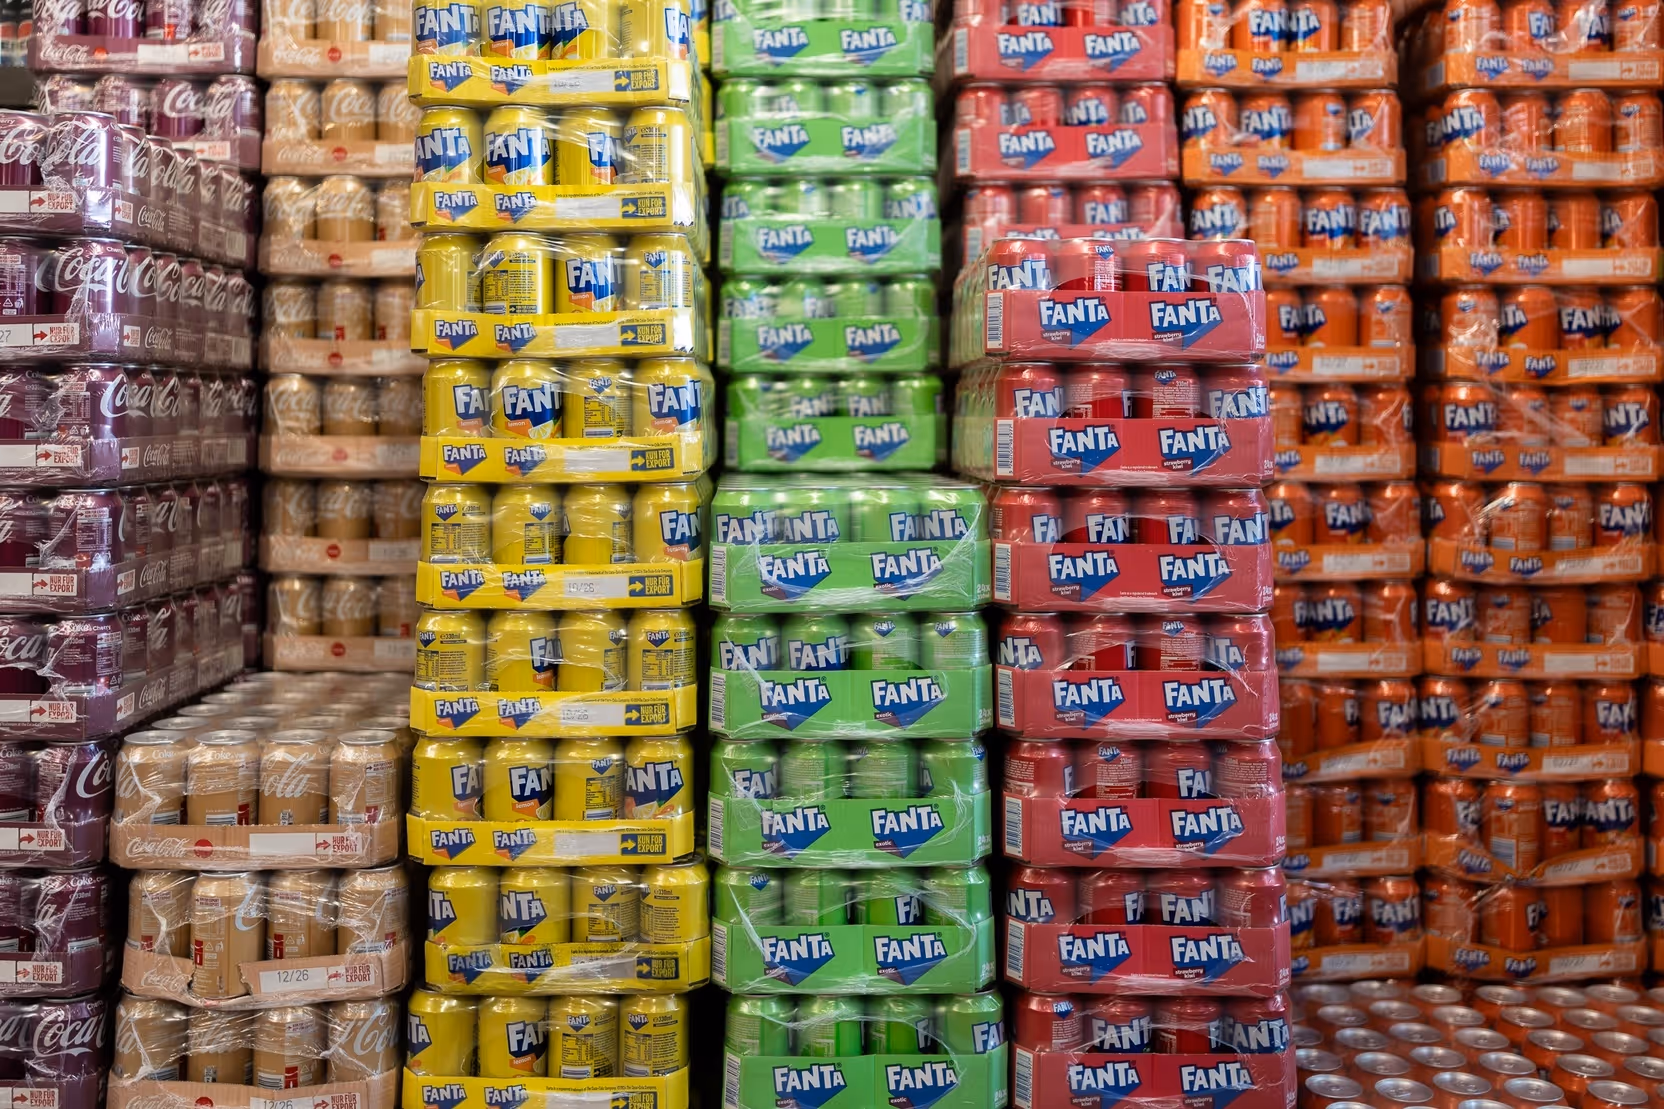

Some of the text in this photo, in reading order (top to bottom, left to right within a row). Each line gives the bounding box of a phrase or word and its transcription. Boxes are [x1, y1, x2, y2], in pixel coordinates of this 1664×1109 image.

[415, 4, 480, 35] FANTA
[754, 27, 809, 49] FANTA
[841, 27, 896, 50] FANTA
[998, 32, 1054, 55] FANTA
[1085, 32, 1141, 56] FANTA
[429, 61, 473, 79] FANTA
[490, 64, 534, 80] FANTA
[630, 79, 656, 89] EXPORT
[754, 125, 810, 147] FANTA
[842, 124, 897, 148] FANTA
[998, 131, 1055, 155] FANTA
[1086, 130, 1143, 155] FANTA
[485, 128, 550, 163] FANTA
[434, 191, 479, 209] FANTA
[494, 192, 537, 210] FANTA
[637, 198, 649, 208] KUN
[637, 206, 664, 217] EXPORT
[759, 226, 812, 248] FANTA
[846, 226, 898, 249] FANTA
[1266, 253, 1299, 267] FANTA
[1041, 298, 1109, 327] FANTA
[1150, 298, 1221, 328] FANTA
[434, 320, 479, 338] FANTA
[494, 322, 537, 342] FANTA
[637, 325, 648, 335] KUN
[758, 324, 813, 346] FANTA
[845, 324, 901, 346] FANTA
[1154, 331, 1183, 340] strawberry
[637, 334, 663, 343] EXPORT
[1266, 352, 1299, 365] FANTA
[1525, 357, 1557, 371] FANTA
[507, 420, 526, 428] lemon
[767, 424, 821, 447] FANTA
[854, 423, 909, 447] FANTA
[1050, 426, 1119, 454] FANTA
[1159, 426, 1231, 455] FANTA
[443, 445, 487, 462] FANTA
[504, 446, 546, 464] FANTA
[645, 451, 658, 461] KUN
[1472, 451, 1504, 465] FANTA
[1519, 453, 1551, 466] FANTA
[645, 458, 672, 469] EXPORT
[1052, 458, 1081, 466] strawberry
[1163, 458, 1192, 467] strawberry
[435, 504, 459, 516] FANTA
[871, 549, 942, 578] FANTA
[1279, 550, 1311, 564] FANTA
[1510, 557, 1543, 570] FANTA
[760, 552, 831, 579] FANTA
[1050, 553, 1119, 580] FANTA
[1159, 552, 1230, 581] FANTA
[49, 575, 62, 584] NUR
[440, 571, 484, 588] FANTA
[502, 570, 546, 590] FANTA
[645, 577, 658, 587] NUR
[49, 583, 75, 593] EXPORT
[645, 584, 671, 596] EXPORT
[1052, 584, 1081, 593] strawberry
[1163, 585, 1192, 593] strawberry
[873, 620, 896, 631] FANTA
[419, 630, 437, 642] FANTA
[646, 631, 671, 643] FANTA
[761, 679, 831, 706] FANTA
[872, 678, 943, 707] FANTA
[1054, 679, 1124, 707] FANTA
[1164, 678, 1236, 708] FANTA
[48, 702, 60, 711] NUR
[435, 698, 480, 716] FANTA
[498, 697, 543, 716] FANTA
[640, 705, 654, 716] NUR
[640, 714, 667, 724] EXPORT
[875, 711, 894, 720] exotic
[1168, 712, 1197, 720] strawberry
[1497, 752, 1531, 767] FANTA
[515, 802, 535, 810] lemon
[761, 806, 829, 834] FANTA
[872, 806, 943, 835] FANTA
[1061, 807, 1132, 837] FANTA
[1172, 807, 1244, 837] FANTA
[37, 830, 48, 839] NUR
[431, 829, 476, 847] FANTA
[493, 830, 537, 848] FANTA
[637, 836, 649, 845] KUN
[37, 839, 62, 848] EXPORT
[637, 843, 664, 854] EXPORT
[763, 841, 781, 849] exotic
[875, 840, 893, 848] exotic
[1063, 840, 1093, 849] strawberry
[70, 876, 94, 887] Coke
[592, 885, 617, 896] FANTA
[762, 934, 833, 962] FANTA
[875, 933, 947, 963] FANTA
[1059, 933, 1131, 962] FANTA
[1172, 933, 1244, 964] FANTA
[449, 952, 494, 970] FANTA
[510, 951, 553, 970] FANTA
[32, 965, 44, 974] NUR
[276, 969, 309, 984] 12/26
[345, 963, 371, 975] NUR FÜR
[651, 968, 676, 979] EXPORT
[879, 967, 896, 975] exotic
[1175, 968, 1204, 977] strawberry
[32, 973, 57, 982] EXPORT
[345, 973, 371, 983] EXPORT
[567, 1015, 591, 1026] FANTA
[627, 1014, 649, 1025] FANTA
[513, 1056, 532, 1065] lemon
[774, 1063, 846, 1093] FANTA
[886, 1062, 958, 1092] FANTA
[1070, 1062, 1140, 1091] FANTA
[1181, 1062, 1253, 1092] FANTA
[29, 1088, 55, 1099] NUR FÜR
[330, 1092, 357, 1104] NUR FÜR
[422, 1085, 467, 1103] FANTA
[484, 1086, 529, 1104] FANTA
[890, 1097, 908, 1105] exotic
[29, 1099, 55, 1108] EXPORT
[263, 1099, 293, 1109] 12/26
